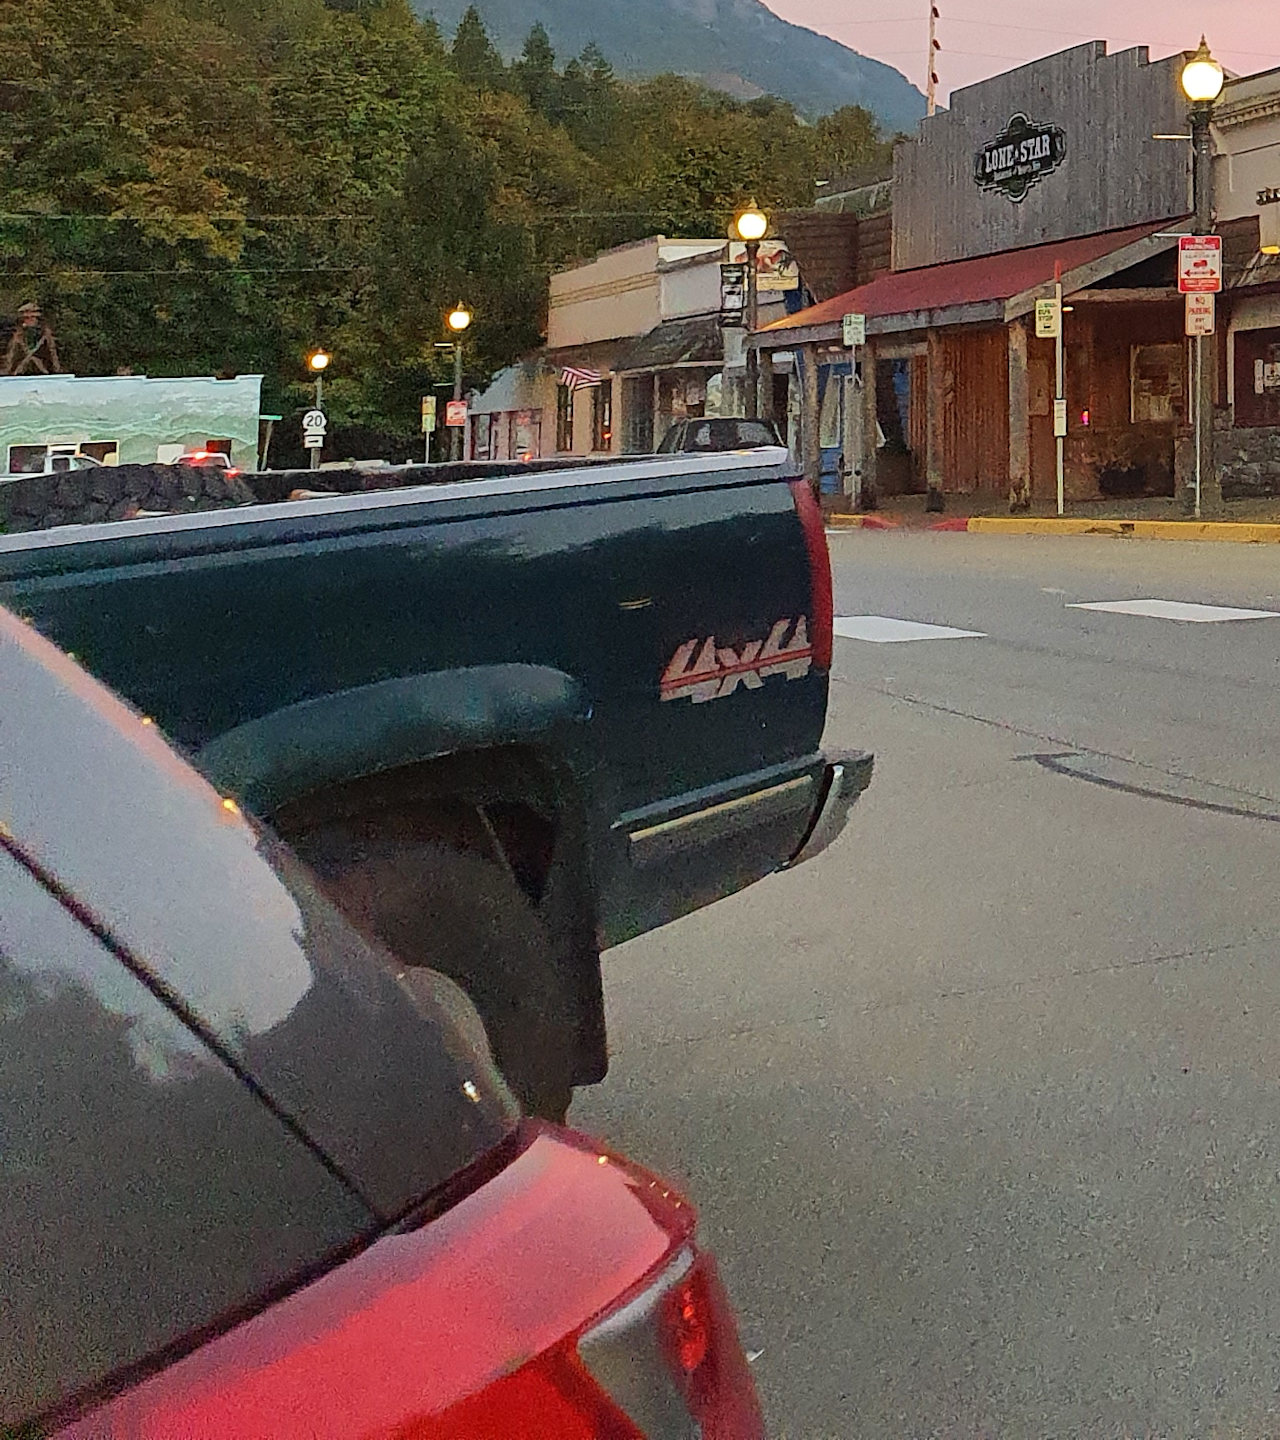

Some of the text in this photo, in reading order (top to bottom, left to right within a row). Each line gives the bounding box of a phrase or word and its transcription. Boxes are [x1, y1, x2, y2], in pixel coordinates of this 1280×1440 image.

[985, 144, 1015, 173] LONE
[1020, 134, 1051, 162] STAR
[307, 415, 323, 427] 20
[659, 614, 813, 704] 4x4
